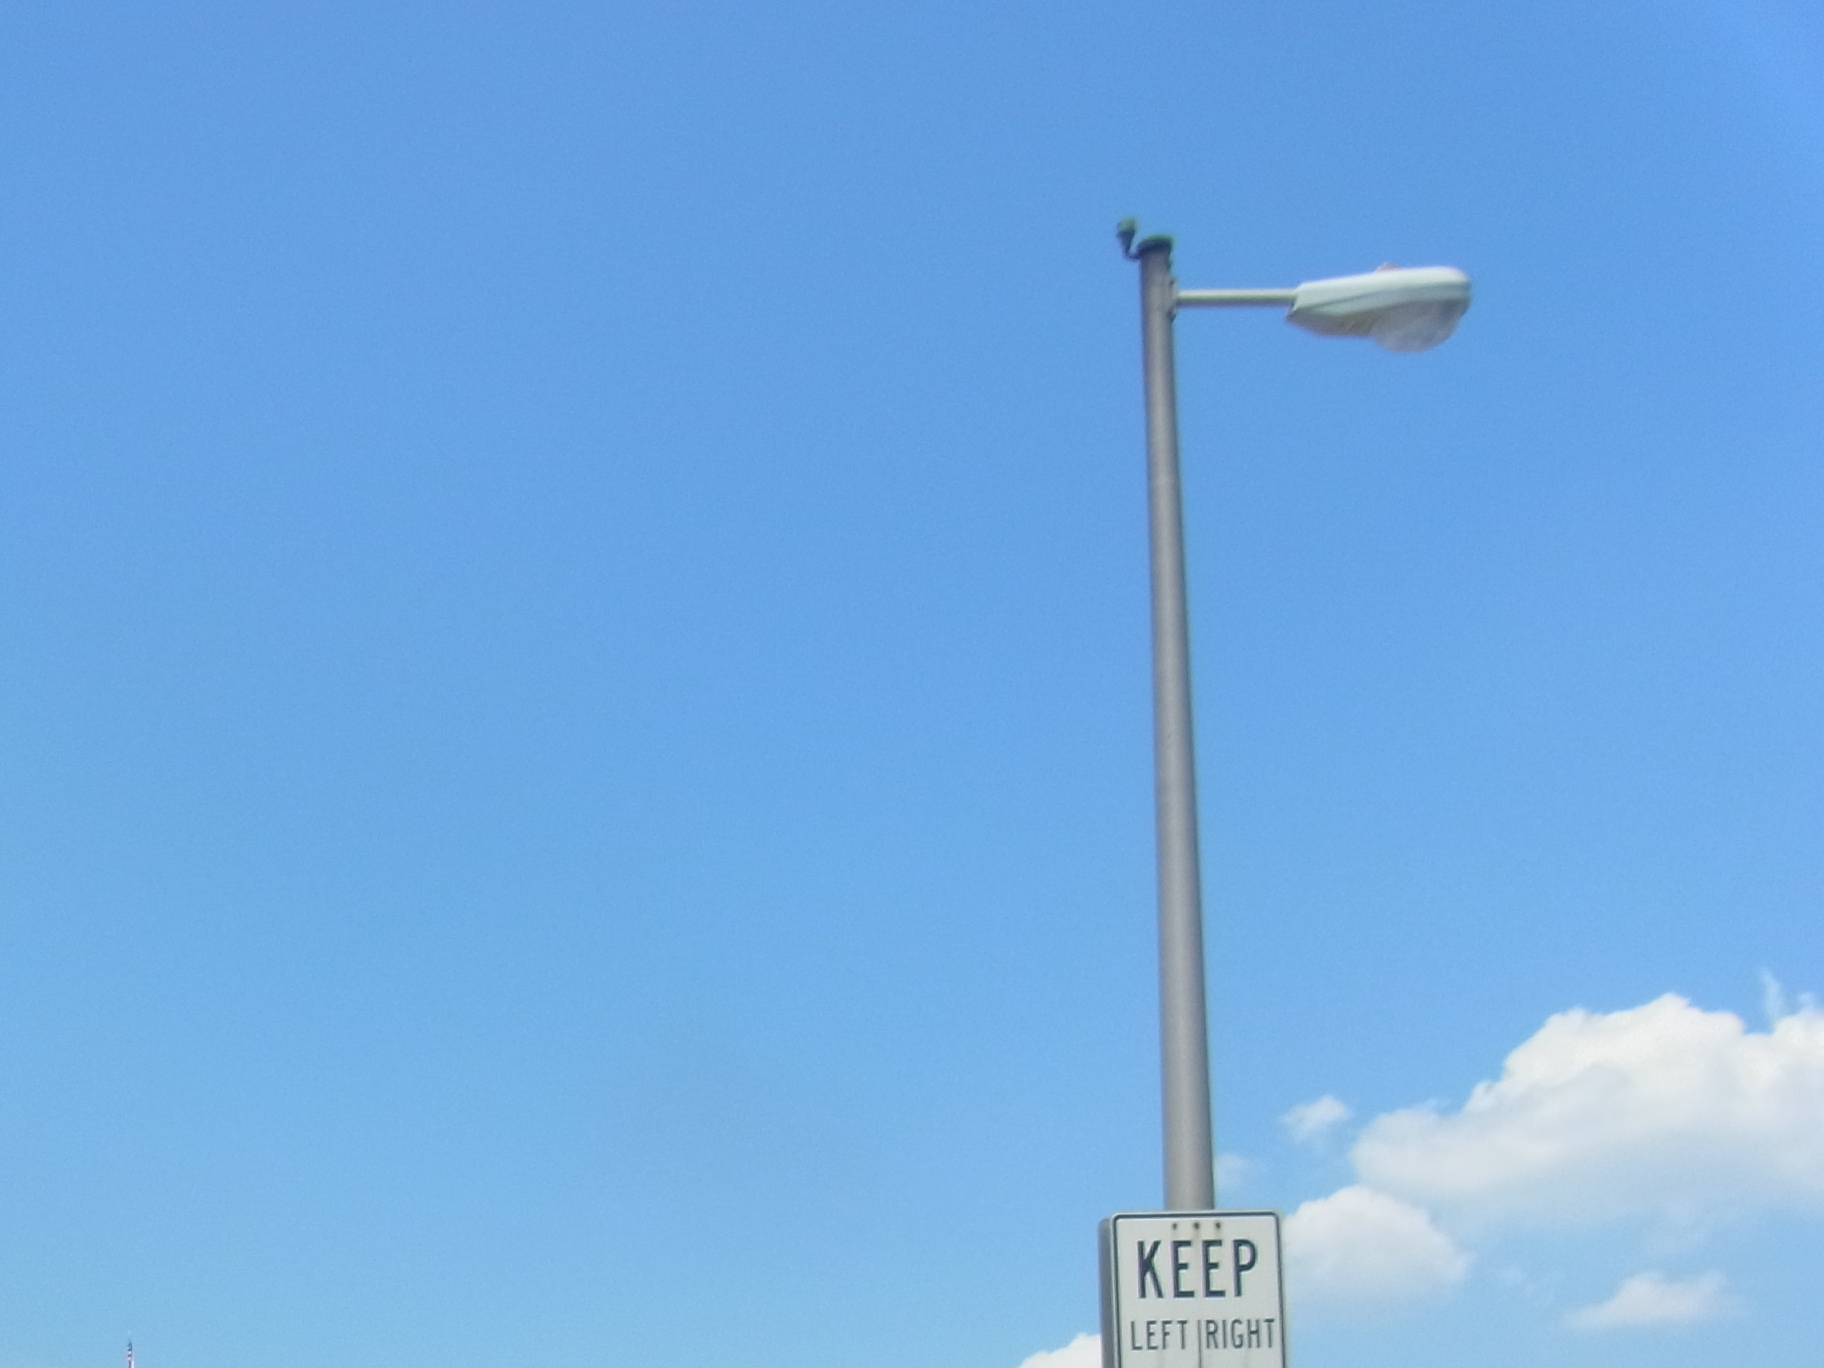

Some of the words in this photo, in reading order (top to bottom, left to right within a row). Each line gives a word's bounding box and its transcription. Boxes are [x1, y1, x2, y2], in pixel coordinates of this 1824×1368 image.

[1137, 1239, 1257, 1299] KEEP
[1130, 1319, 1188, 1351] LEFT
[1206, 1317, 1275, 1350] RIGHT
